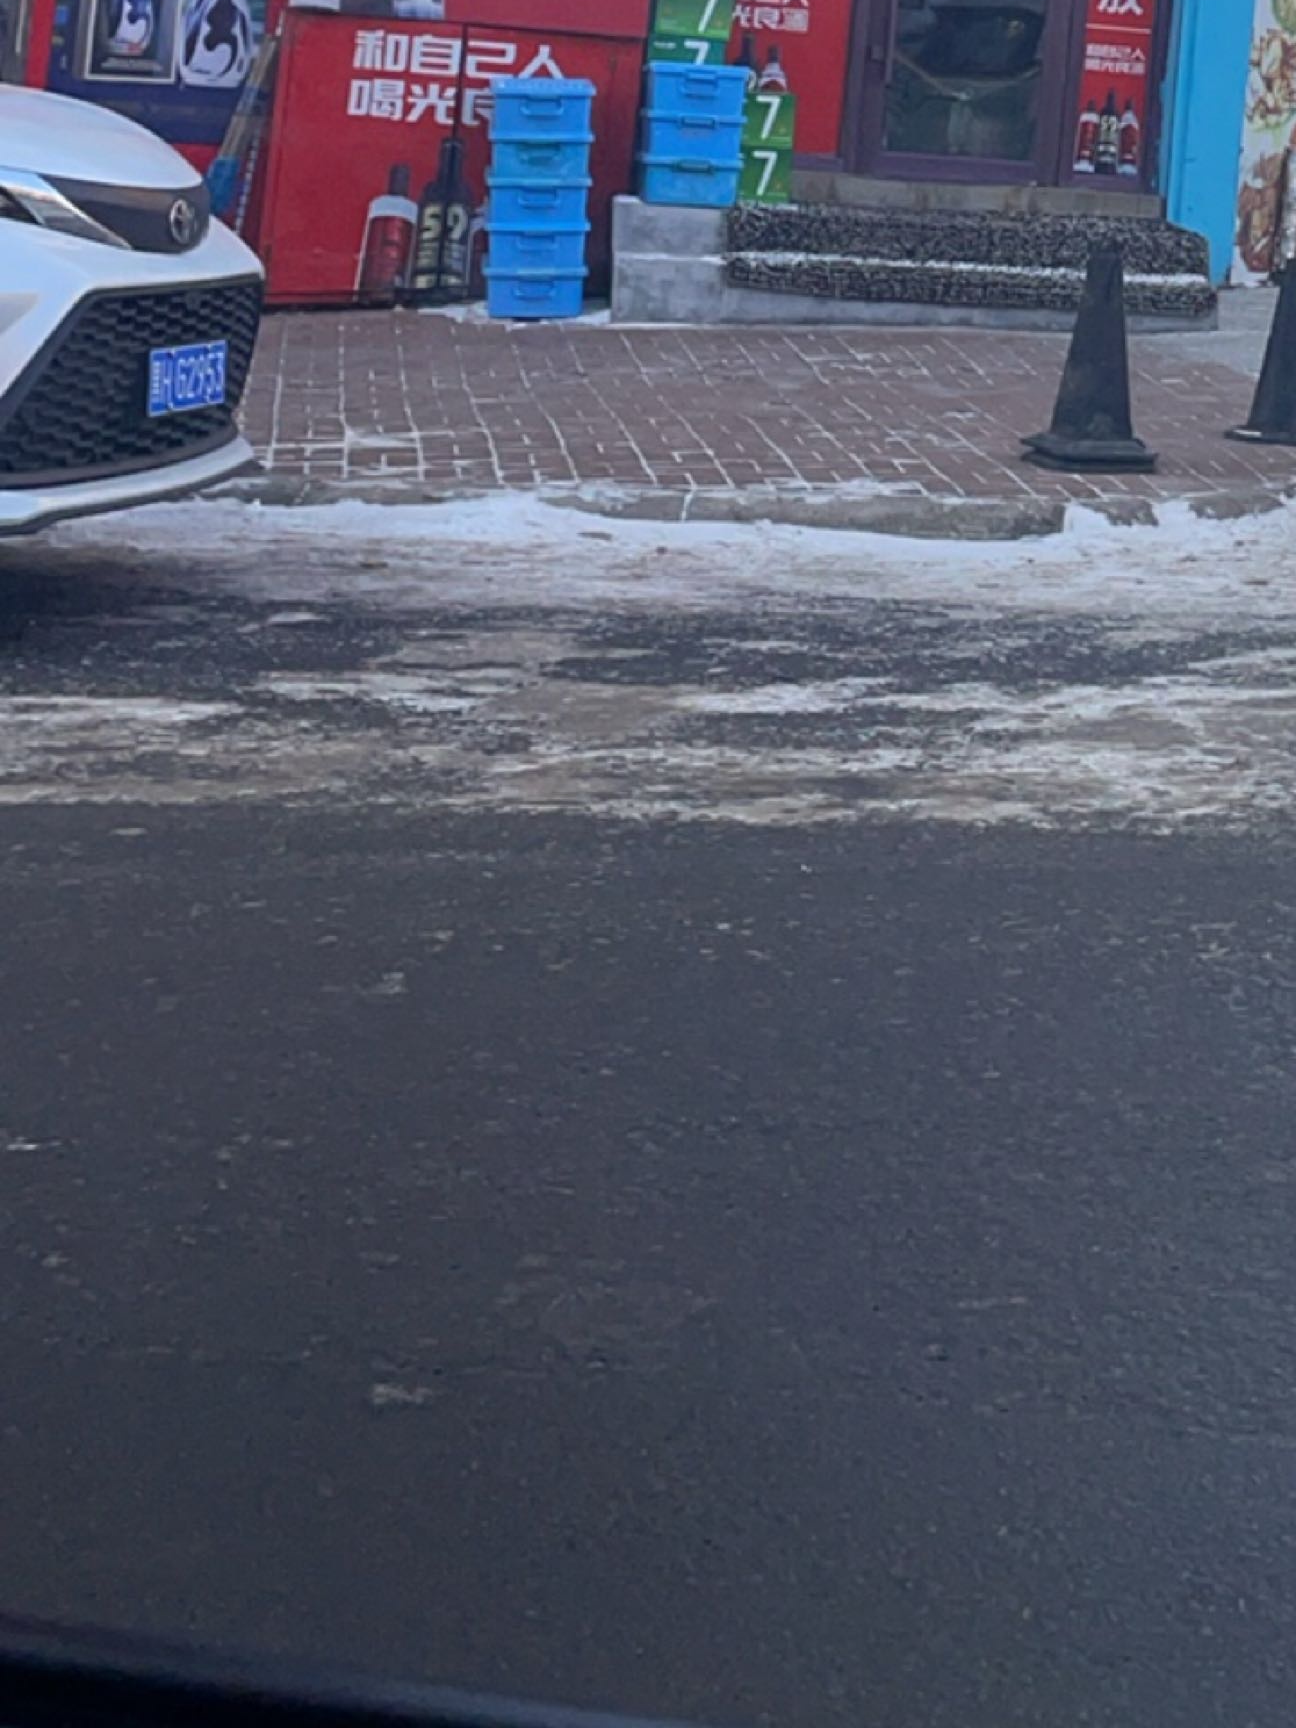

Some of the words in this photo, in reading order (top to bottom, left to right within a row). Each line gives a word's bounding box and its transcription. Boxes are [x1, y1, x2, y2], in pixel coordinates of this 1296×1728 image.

[353, 29, 565, 80] 和自己人
[756, 95, 781, 140] 7
[752, 150, 778, 197] 7
[421, 203, 469, 240] 59
